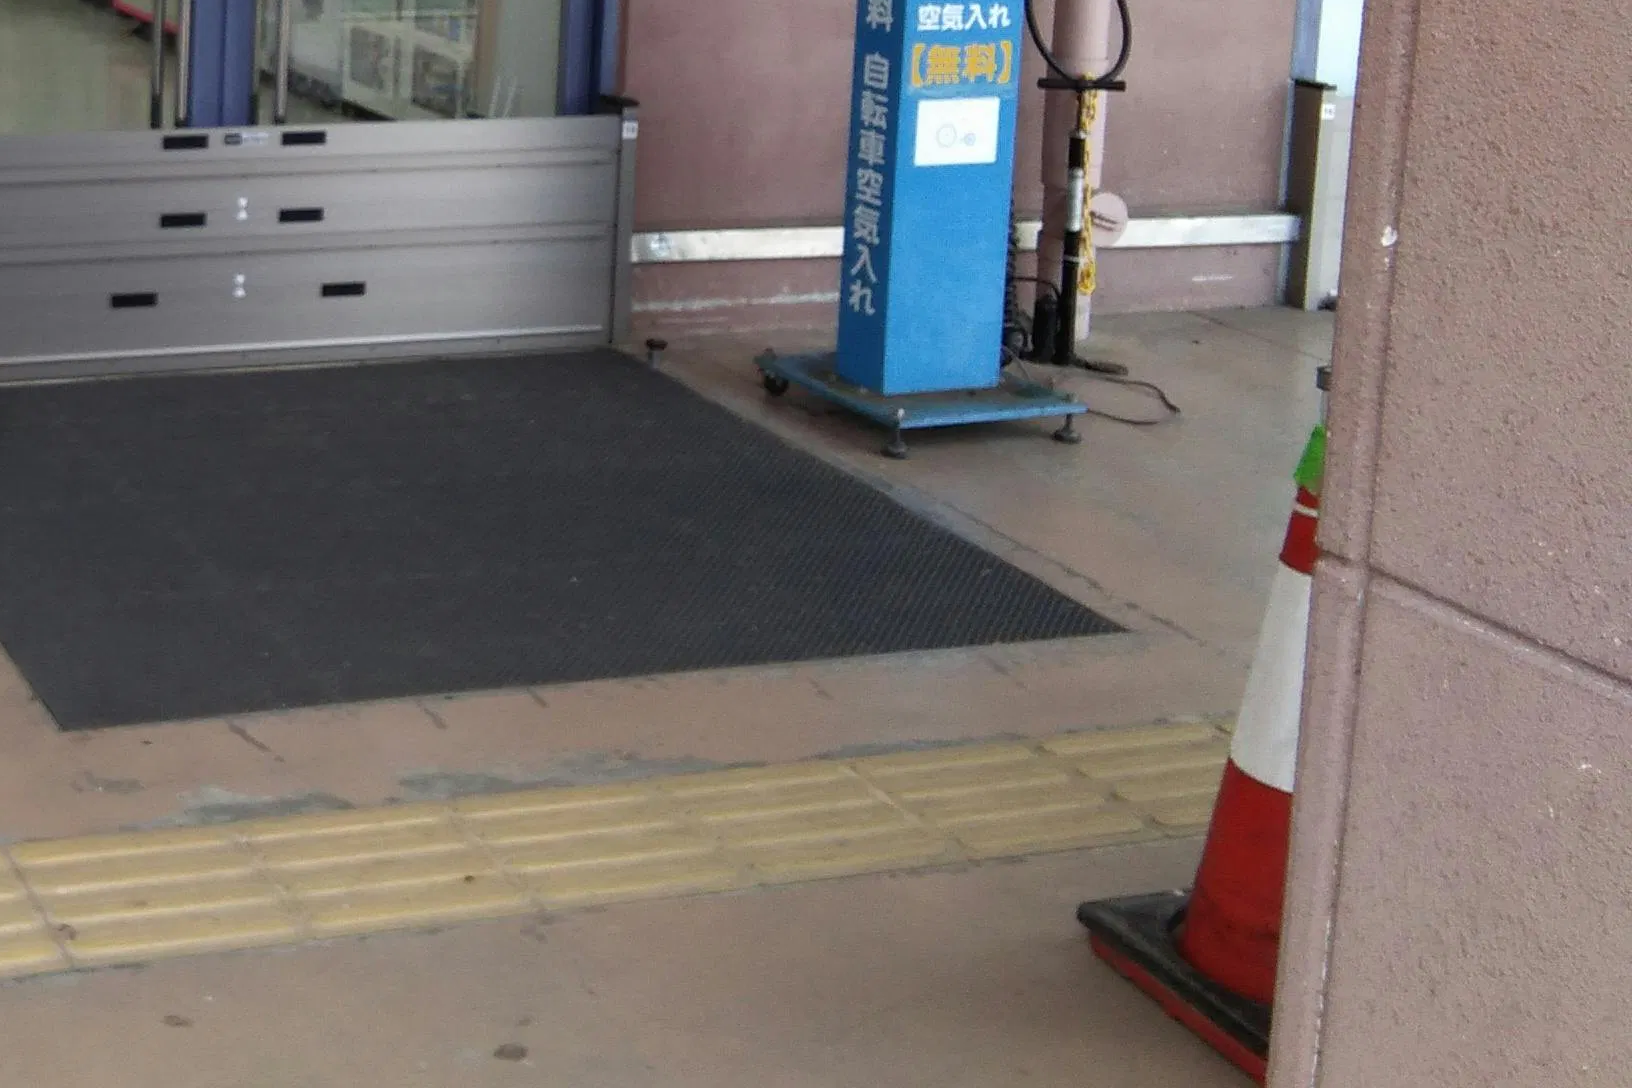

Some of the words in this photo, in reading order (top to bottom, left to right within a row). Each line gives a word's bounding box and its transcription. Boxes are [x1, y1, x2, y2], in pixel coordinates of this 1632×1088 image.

[917, 2, 1011, 32] 空気入れ
[848, 51, 890, 316] 自転車空気入れ
